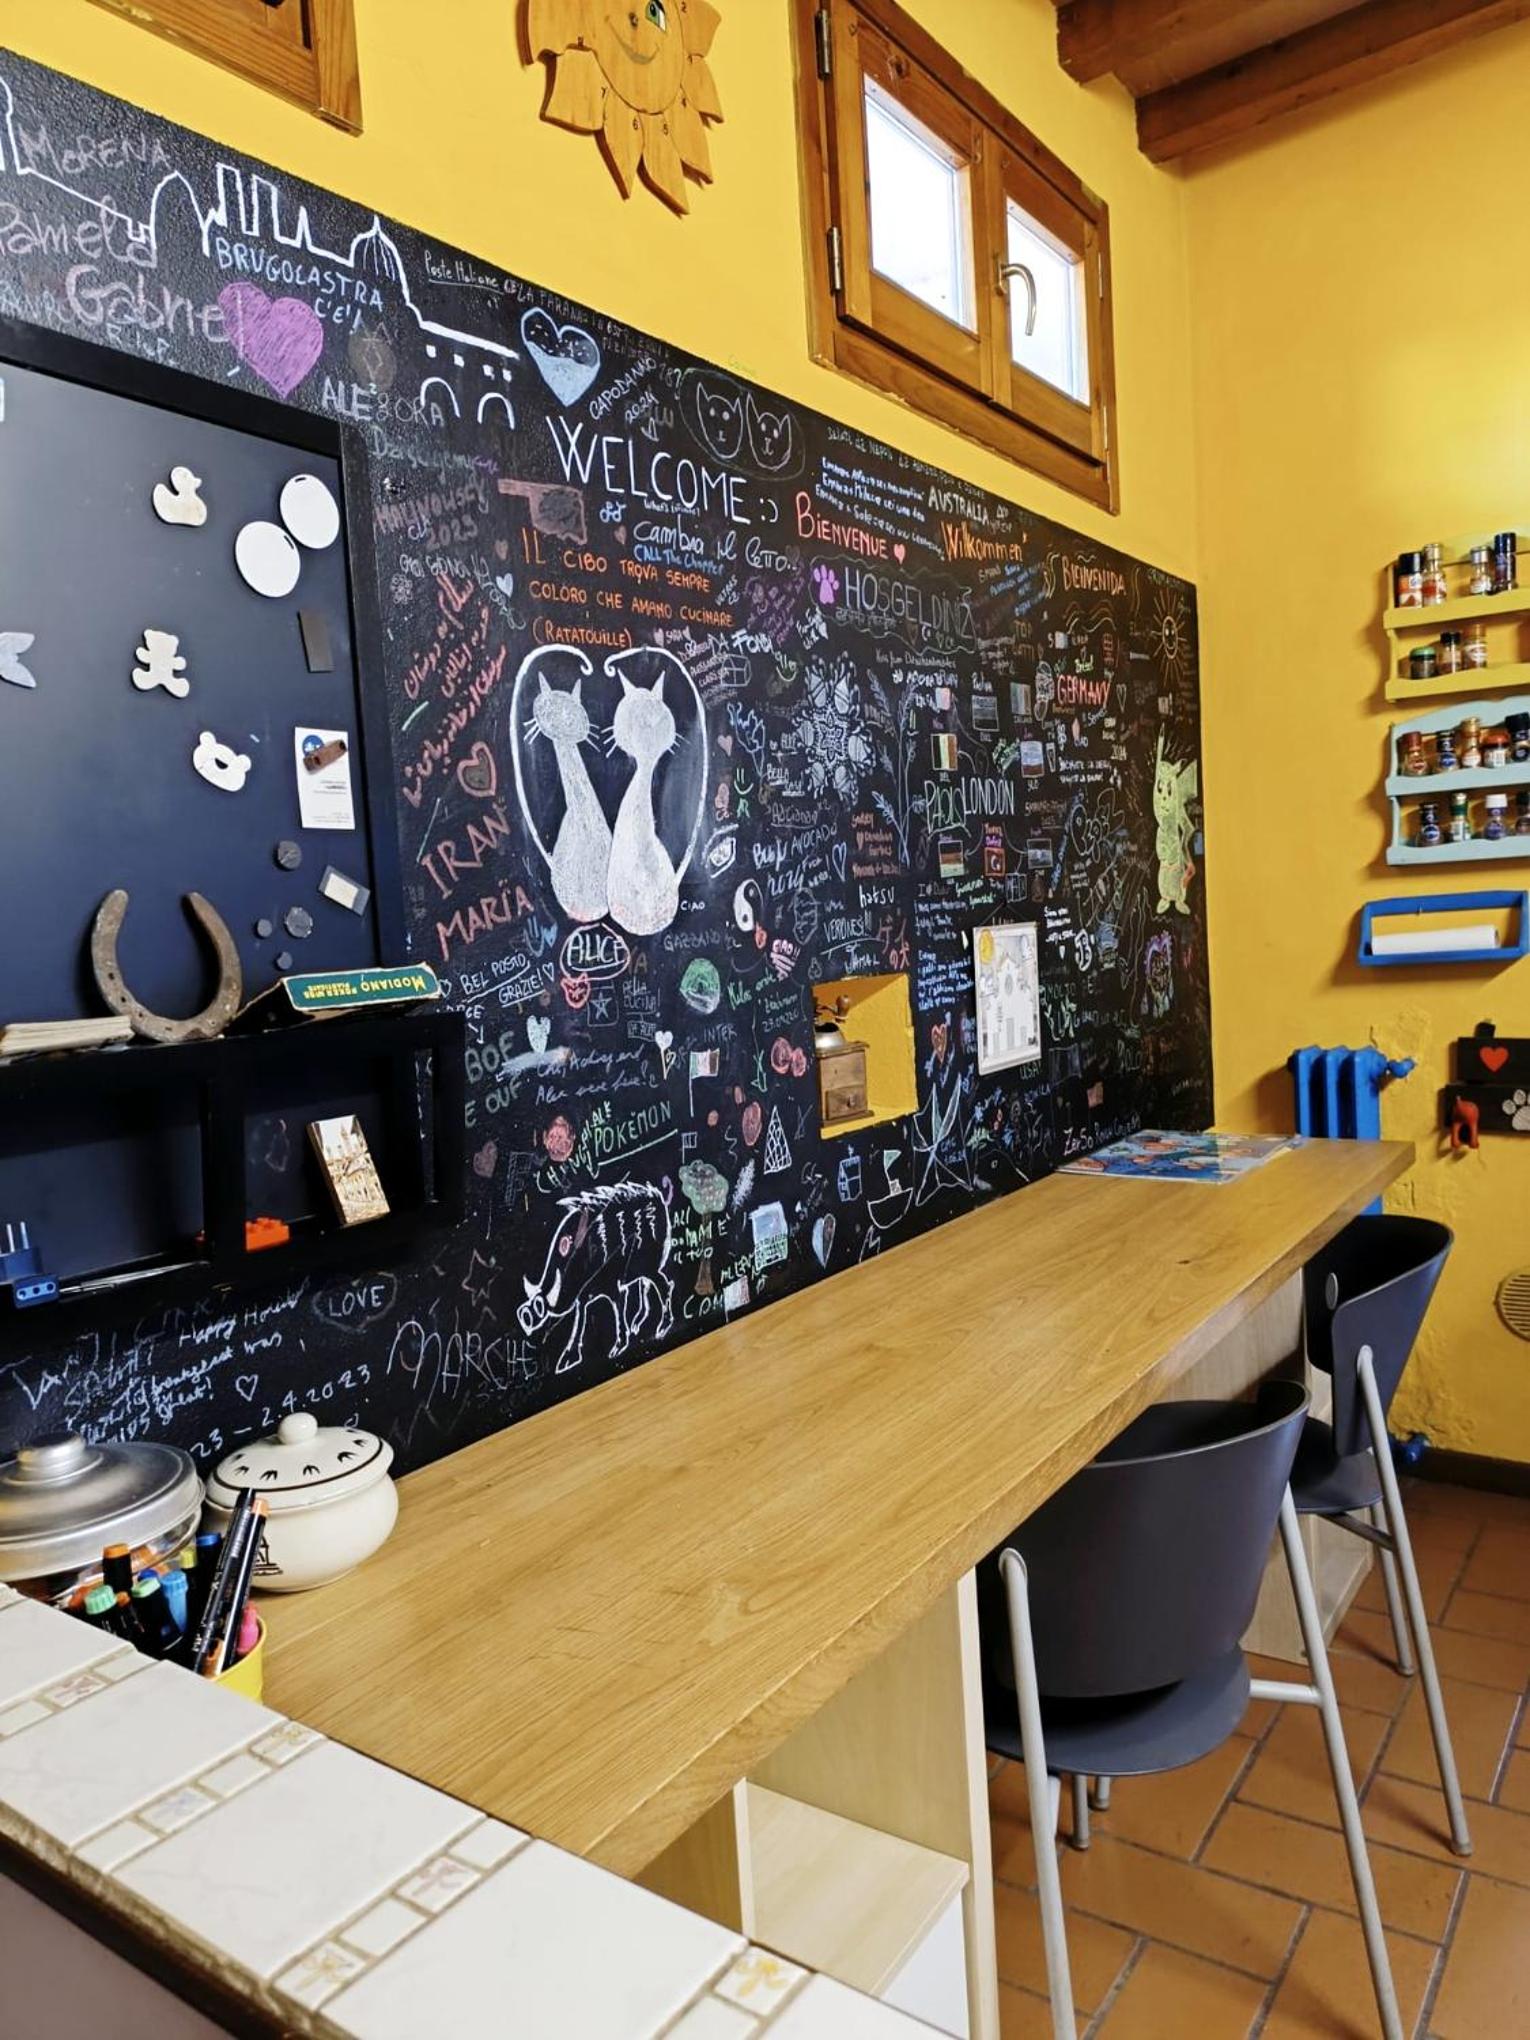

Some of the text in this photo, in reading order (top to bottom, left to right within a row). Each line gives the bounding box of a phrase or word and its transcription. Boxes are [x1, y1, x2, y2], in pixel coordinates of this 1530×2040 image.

[545, 415, 752, 525] WELCOME
[928, 485, 989, 526] AUSTRALIA
[522, 527, 711, 592] IL CIBO TROVA SEMPRE
[528, 580, 587, 605] COLORO
[596, 591, 624, 609] CHE
[631, 597, 674, 620] AMANO
[1057, 673, 1111, 711] GERMANY
[962, 776, 1014, 816] LONDON
[567, 932, 627, 967] ALICE
[361, 975, 426, 992] MODIANO
[460, 953, 528, 996] BEL POSTO
[703, 1023, 748, 1042] INTER
[329, 1285, 385, 1318] LOVE
